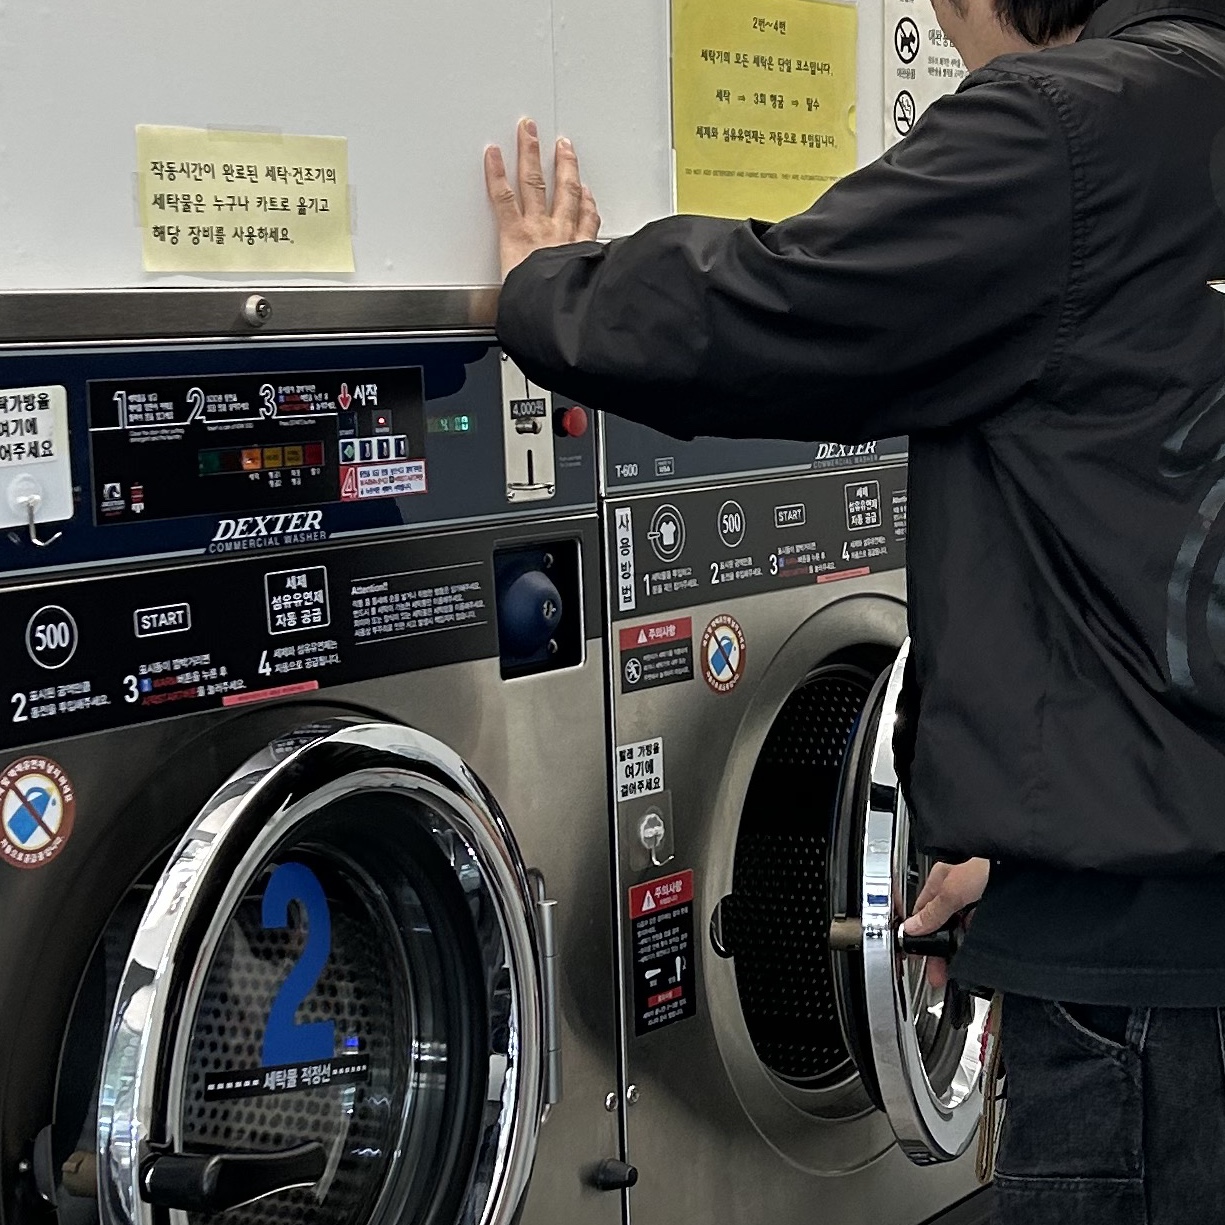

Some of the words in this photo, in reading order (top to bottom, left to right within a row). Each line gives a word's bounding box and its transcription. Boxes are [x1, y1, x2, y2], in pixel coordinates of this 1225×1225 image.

[701, 49, 731, 64] 세탁기의
[734, 53, 749, 68] 모든
[753, 55, 774, 71] 세탁은
[716, 89, 730, 105] 세탁
[696, 126, 718, 139] 세제와
[769, 132, 797, 147] 자동으로
[150, 160, 215, 181] 작동시간이
[222, 163, 258, 183] 완료된
[152, 193, 206, 213] 세탁물은
[213, 195, 250, 212] 누구나
[256, 195, 291, 212] 카트로
[297, 196, 330, 216] 옮기고
[152, 225, 180, 245] 해당
[188, 225, 226, 245] 장비를
[232, 225, 295, 245] 사용하세요.
[353, 384, 378, 406] 시작
[615, 463, 639, 478] T-600
[341, 467, 357, 498] 4
[211, 510, 323, 542] DEXTER
[722, 513, 741, 534] 500
[778, 509, 802, 522] START
[208, 536, 281, 554] COMMERCIAL
[283, 531, 327, 546] WASHER
[842, 542, 850, 561] 4
[618, 514, 633, 604] 사용방법
[769, 554, 779, 575] 3
[285, 574, 307, 590] 세제
[643, 573, 651, 596] 1
[710, 562, 720, 585] 2
[271, 589, 324, 611] 섬유유연제
[140, 610, 185, 630] START
[275, 611, 297, 628] 자동
[300, 607, 322, 624] 공급
[34, 621, 70, 651] 500
[648, 624, 677, 640] 주의사항
[258, 650, 272, 676] 4
[123, 675, 140, 703] 3
[11, 692, 29, 723] 2
[619, 747, 634, 762] 빨래
[637, 742, 660, 758] 가방을
[625, 759, 654, 779] 여기에
[620, 777, 661, 798] 걸어주세요
[261, 861, 336, 1068] 2
[263, 1067, 298, 1091] 세탁물
[300, 1063, 331, 1086] 적정선
